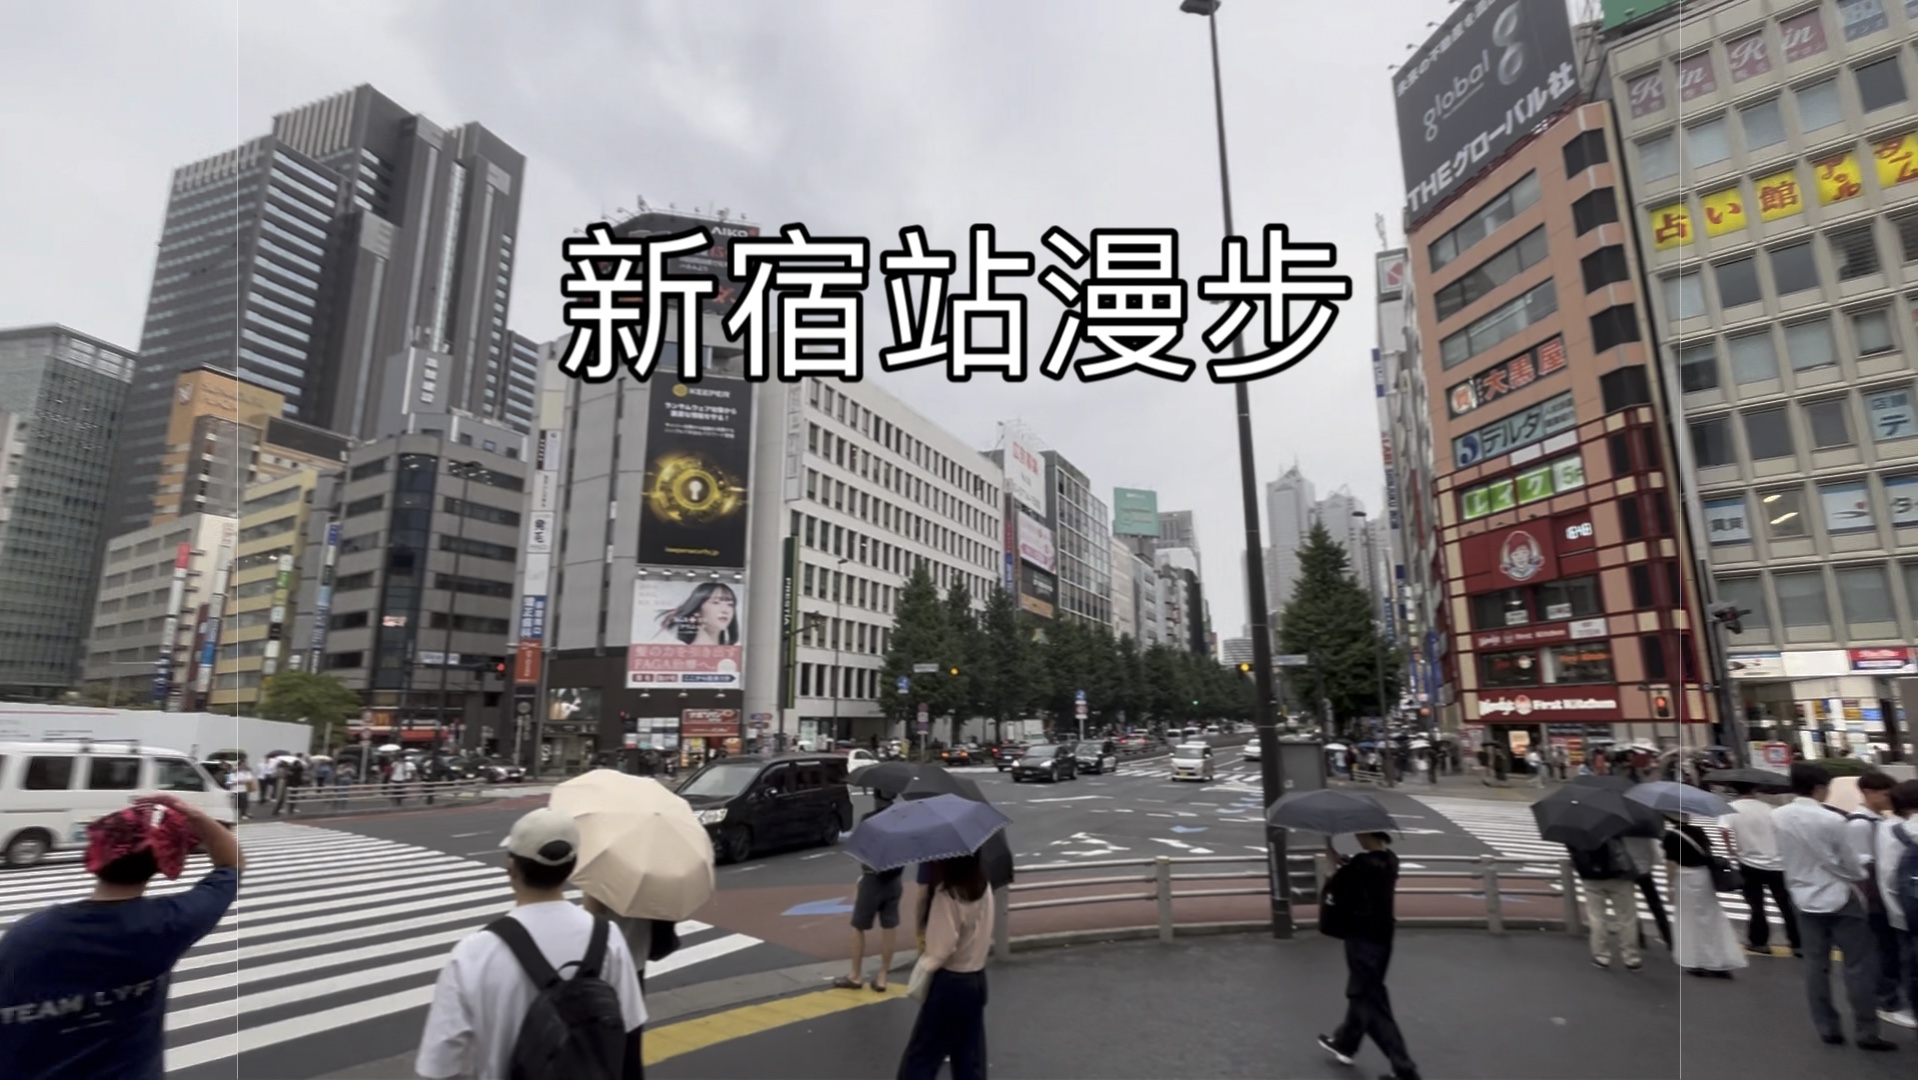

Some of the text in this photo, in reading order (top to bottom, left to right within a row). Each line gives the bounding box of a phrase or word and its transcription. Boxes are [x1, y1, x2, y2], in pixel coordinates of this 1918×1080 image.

[1422, 49, 1491, 142] global
[1406, 61, 1576, 212] THEグローバル社
[1473, 473, 1545, 506] レイク
[0, 995, 85, 1024] TEAM
